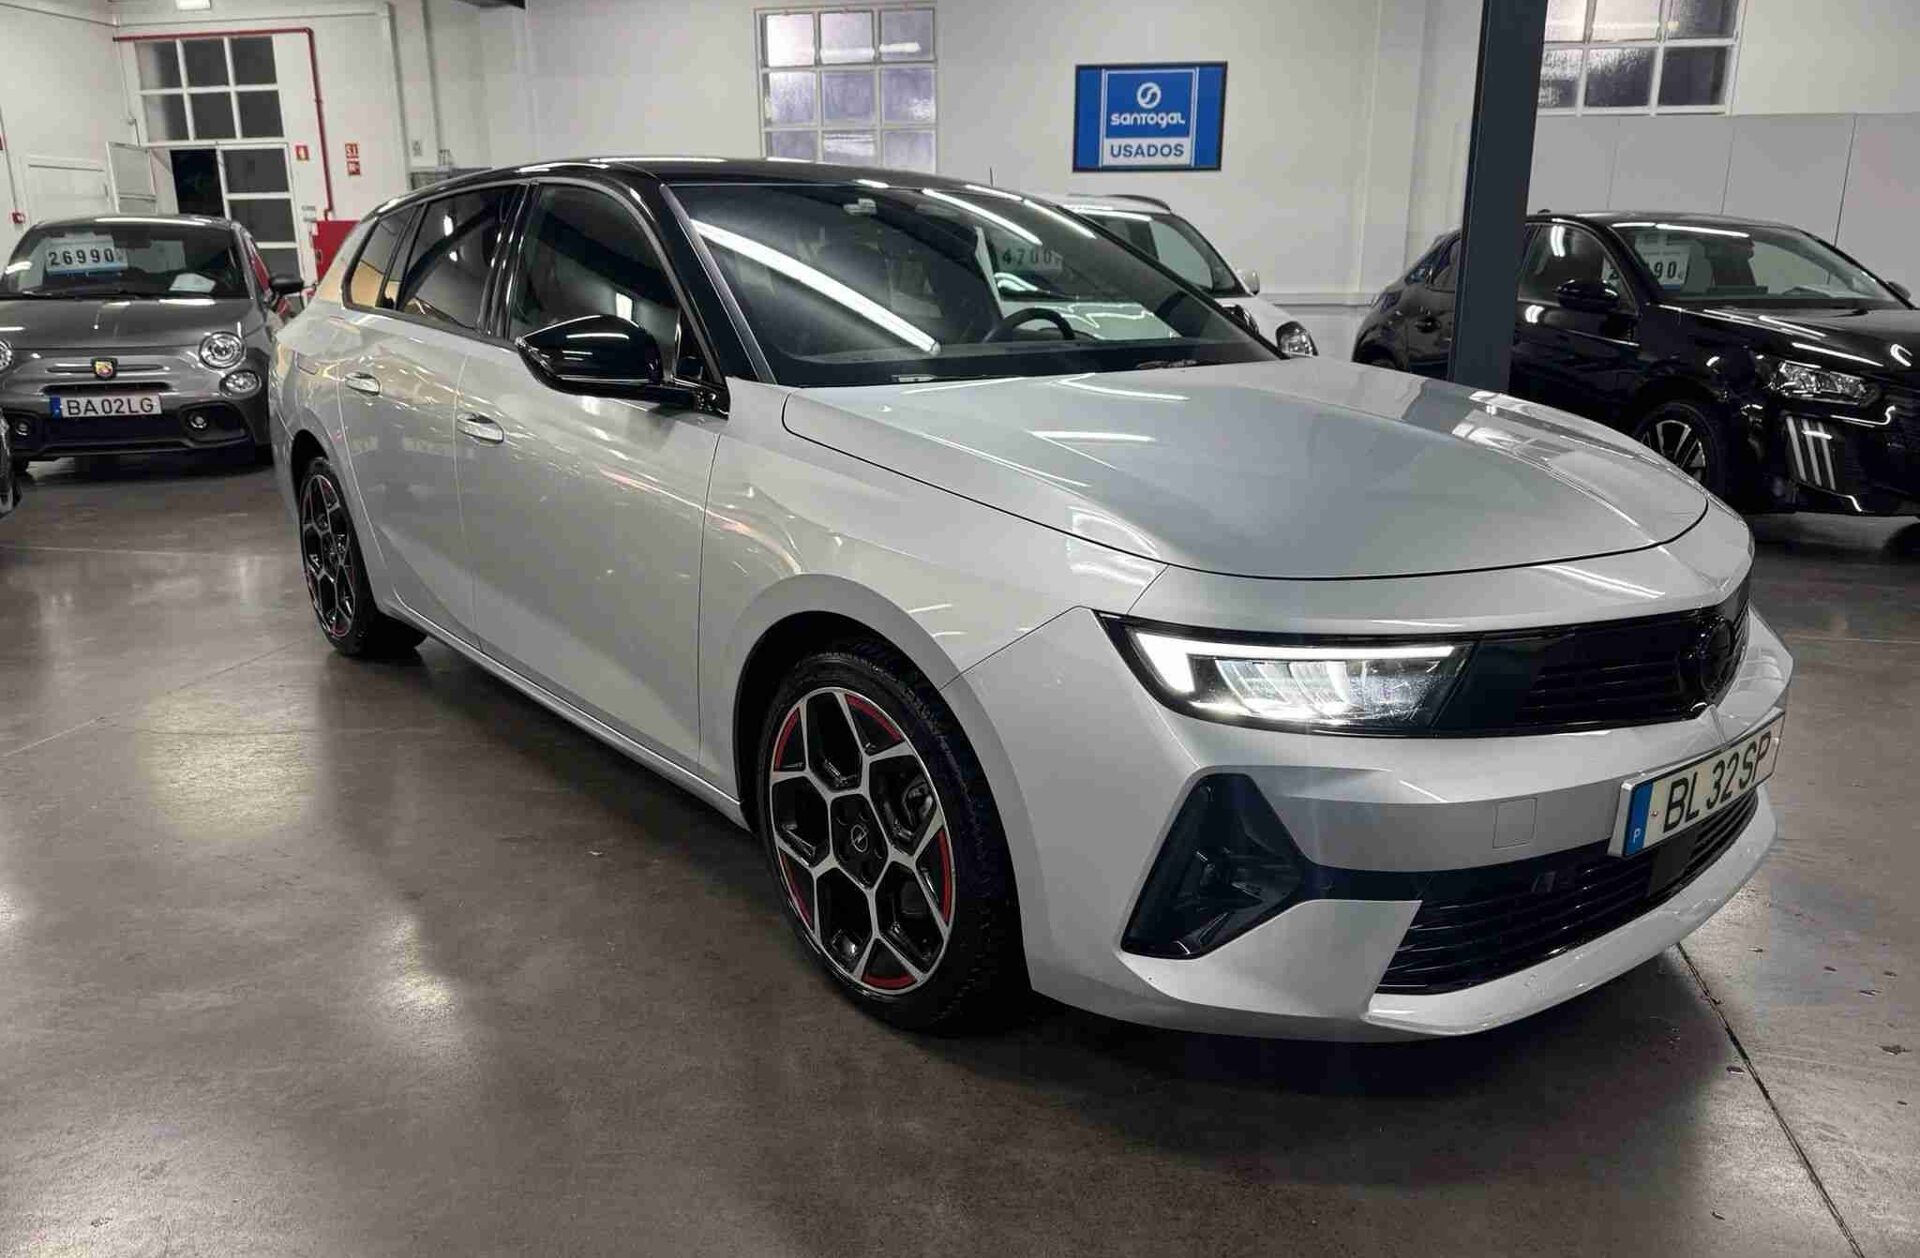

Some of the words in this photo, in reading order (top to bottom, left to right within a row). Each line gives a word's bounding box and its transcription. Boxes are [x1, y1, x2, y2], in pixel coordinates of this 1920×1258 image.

[1111, 143, 1184, 158] USADOS
[48, 248, 114, 266] 26990
[1653, 261, 1677, 279] 90
